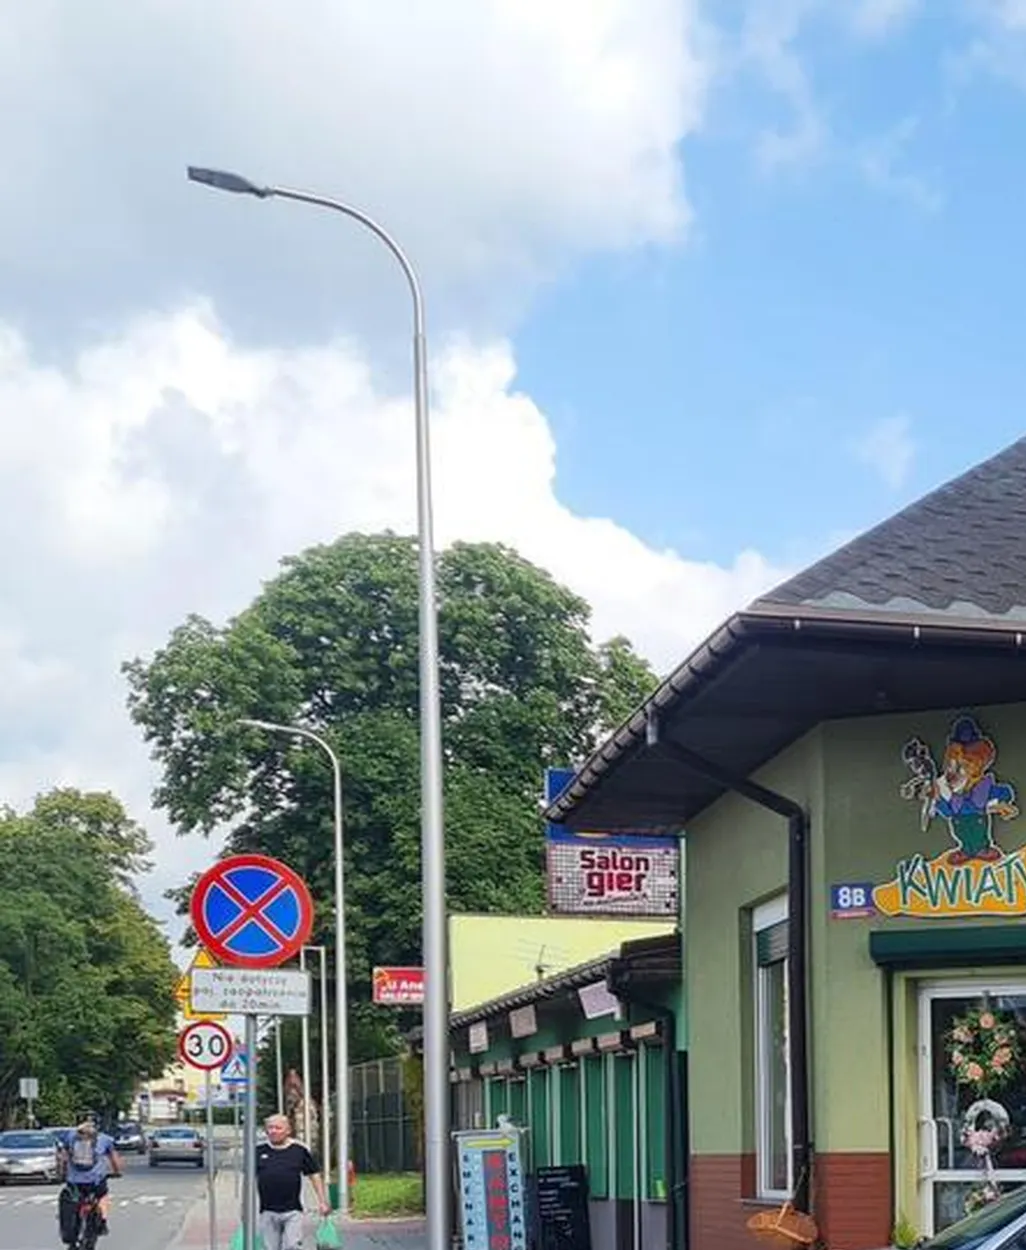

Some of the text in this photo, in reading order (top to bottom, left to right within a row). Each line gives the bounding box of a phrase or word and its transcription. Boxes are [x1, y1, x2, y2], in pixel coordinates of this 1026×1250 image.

[580, 849, 649, 872] Salon
[586, 871, 646, 897] gier
[838, 886, 866, 908] 8B
[188, 1033, 225, 1057] 30
